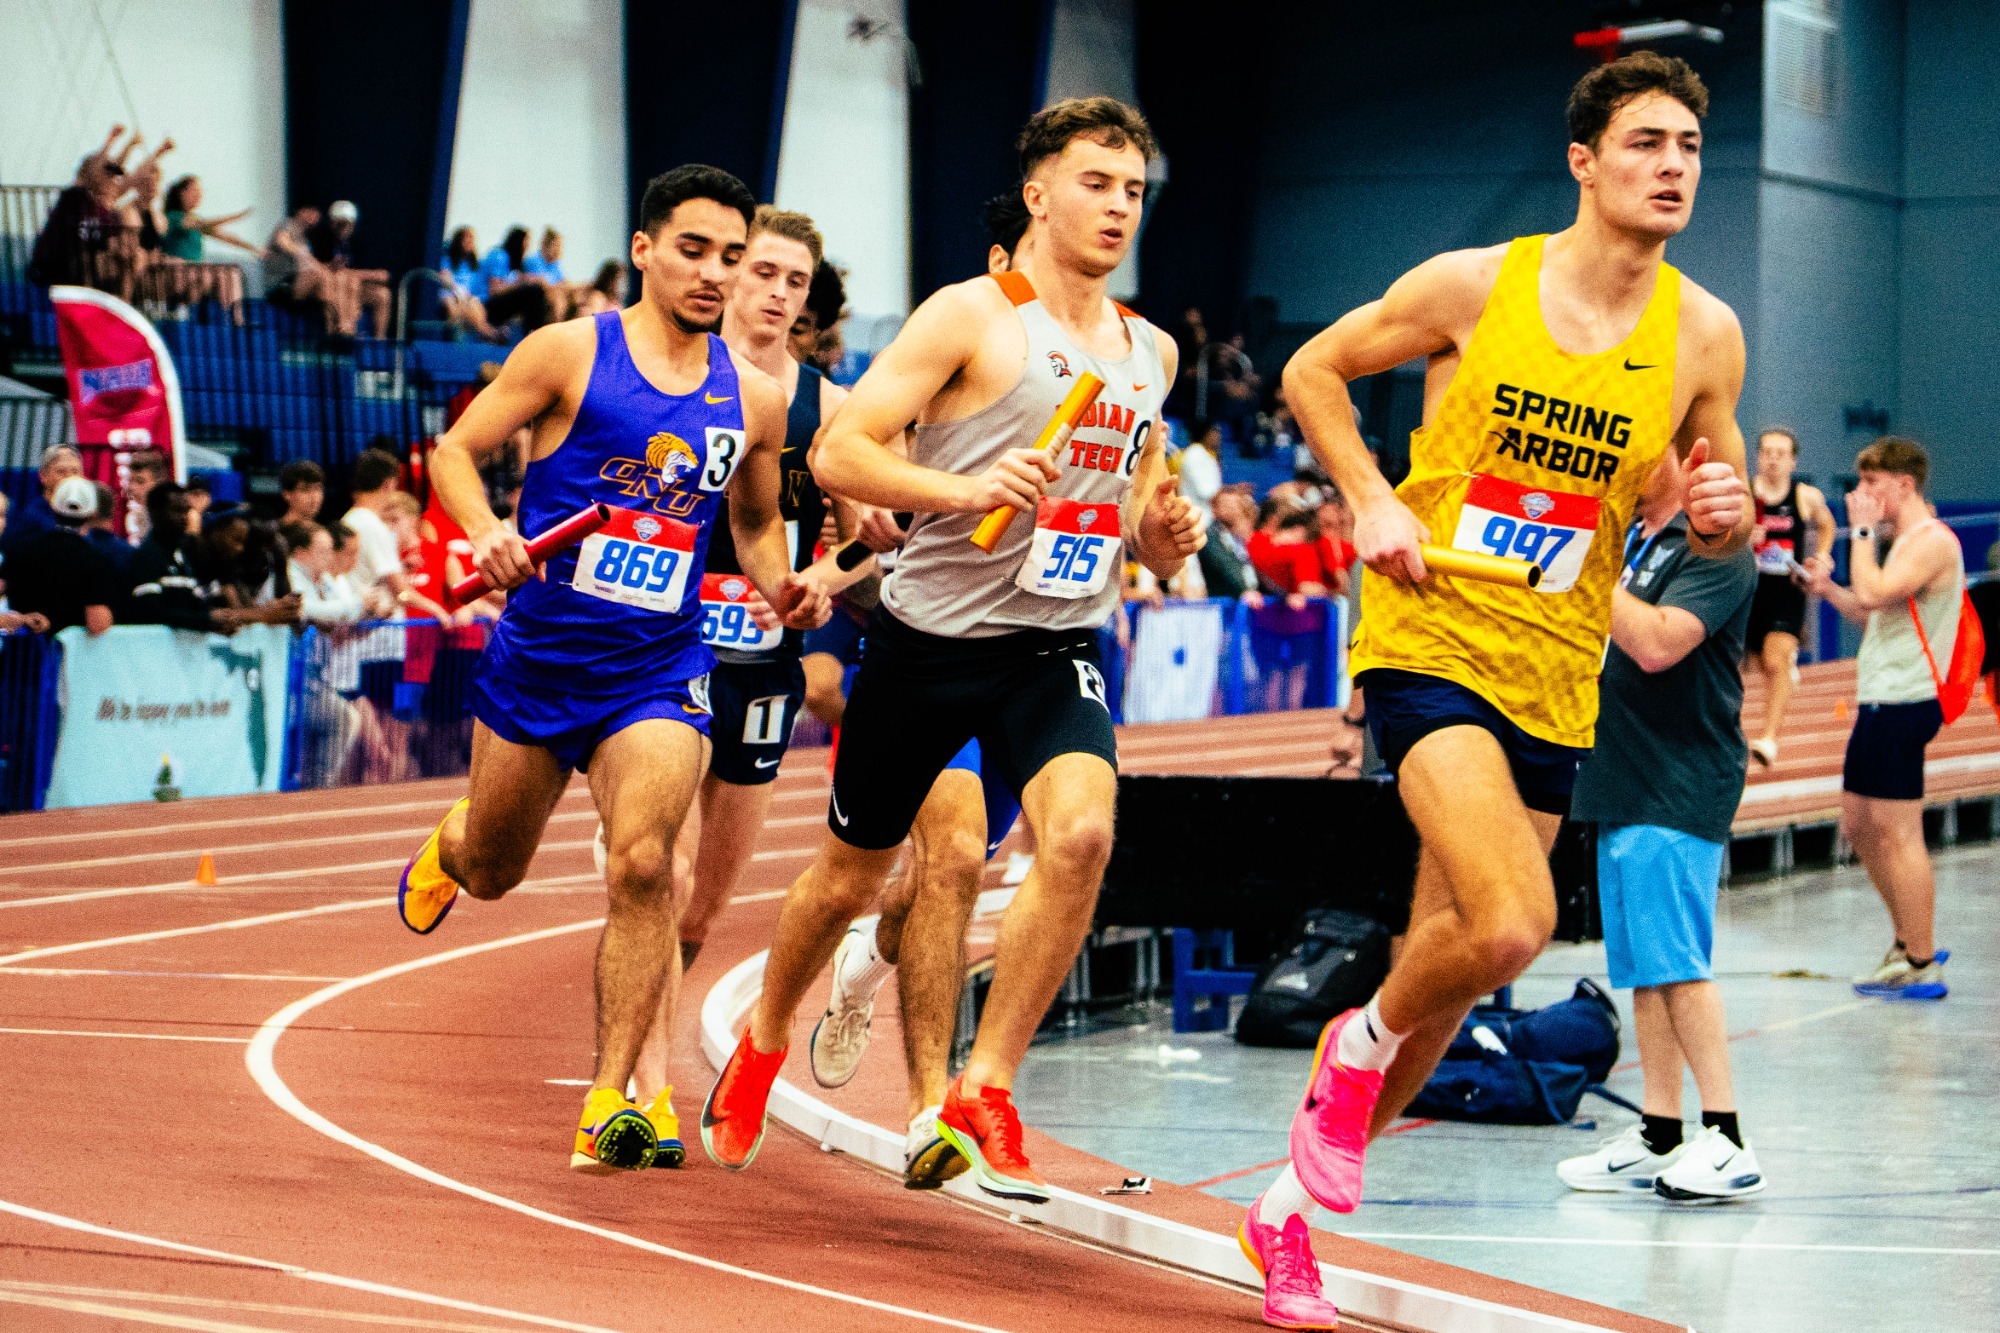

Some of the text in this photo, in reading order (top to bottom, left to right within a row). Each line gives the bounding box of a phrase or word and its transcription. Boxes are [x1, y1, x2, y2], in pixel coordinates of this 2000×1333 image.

[1491, 383, 1633, 449] SPRING
[707, 433, 736, 487] 3
[1125, 420, 1152, 477] 8
[1488, 426, 1620, 484] ARBOR
[594, 539, 679, 594] 869
[1042, 534, 1104, 583] 515
[1482, 516, 1576, 573] 997
[754, 700, 772, 740] 1
